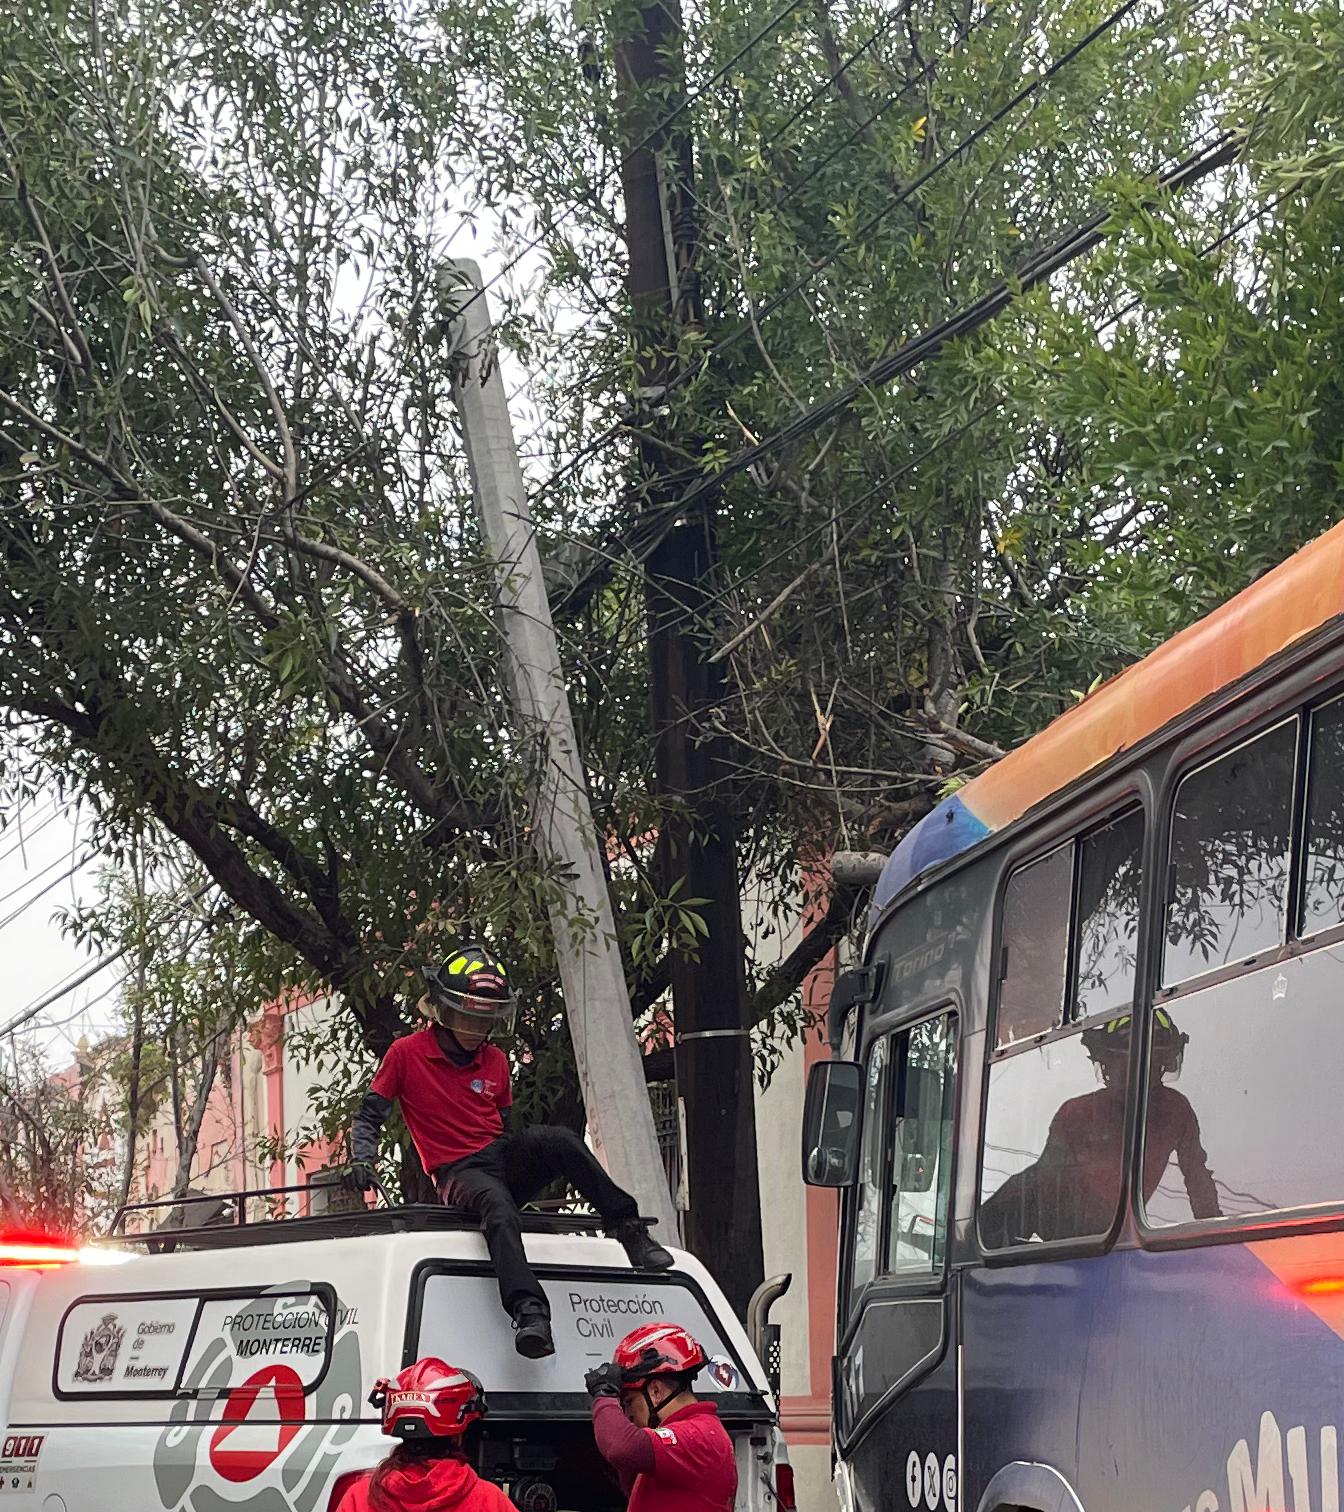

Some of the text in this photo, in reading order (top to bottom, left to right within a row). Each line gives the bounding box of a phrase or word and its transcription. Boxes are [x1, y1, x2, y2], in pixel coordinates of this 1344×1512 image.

[569, 1293, 665, 1315] Protección
[137, 1321, 176, 1335] Gobierno
[222, 1311, 323, 1333] PROTECCION
[576, 1318, 614, 1338] Civil
[132, 1337, 145, 1351] de
[236, 1336, 327, 1357] MONTERRE
[123, 1366, 169, 1380] Monterrey
[3, 1437, 42, 1456] 911
